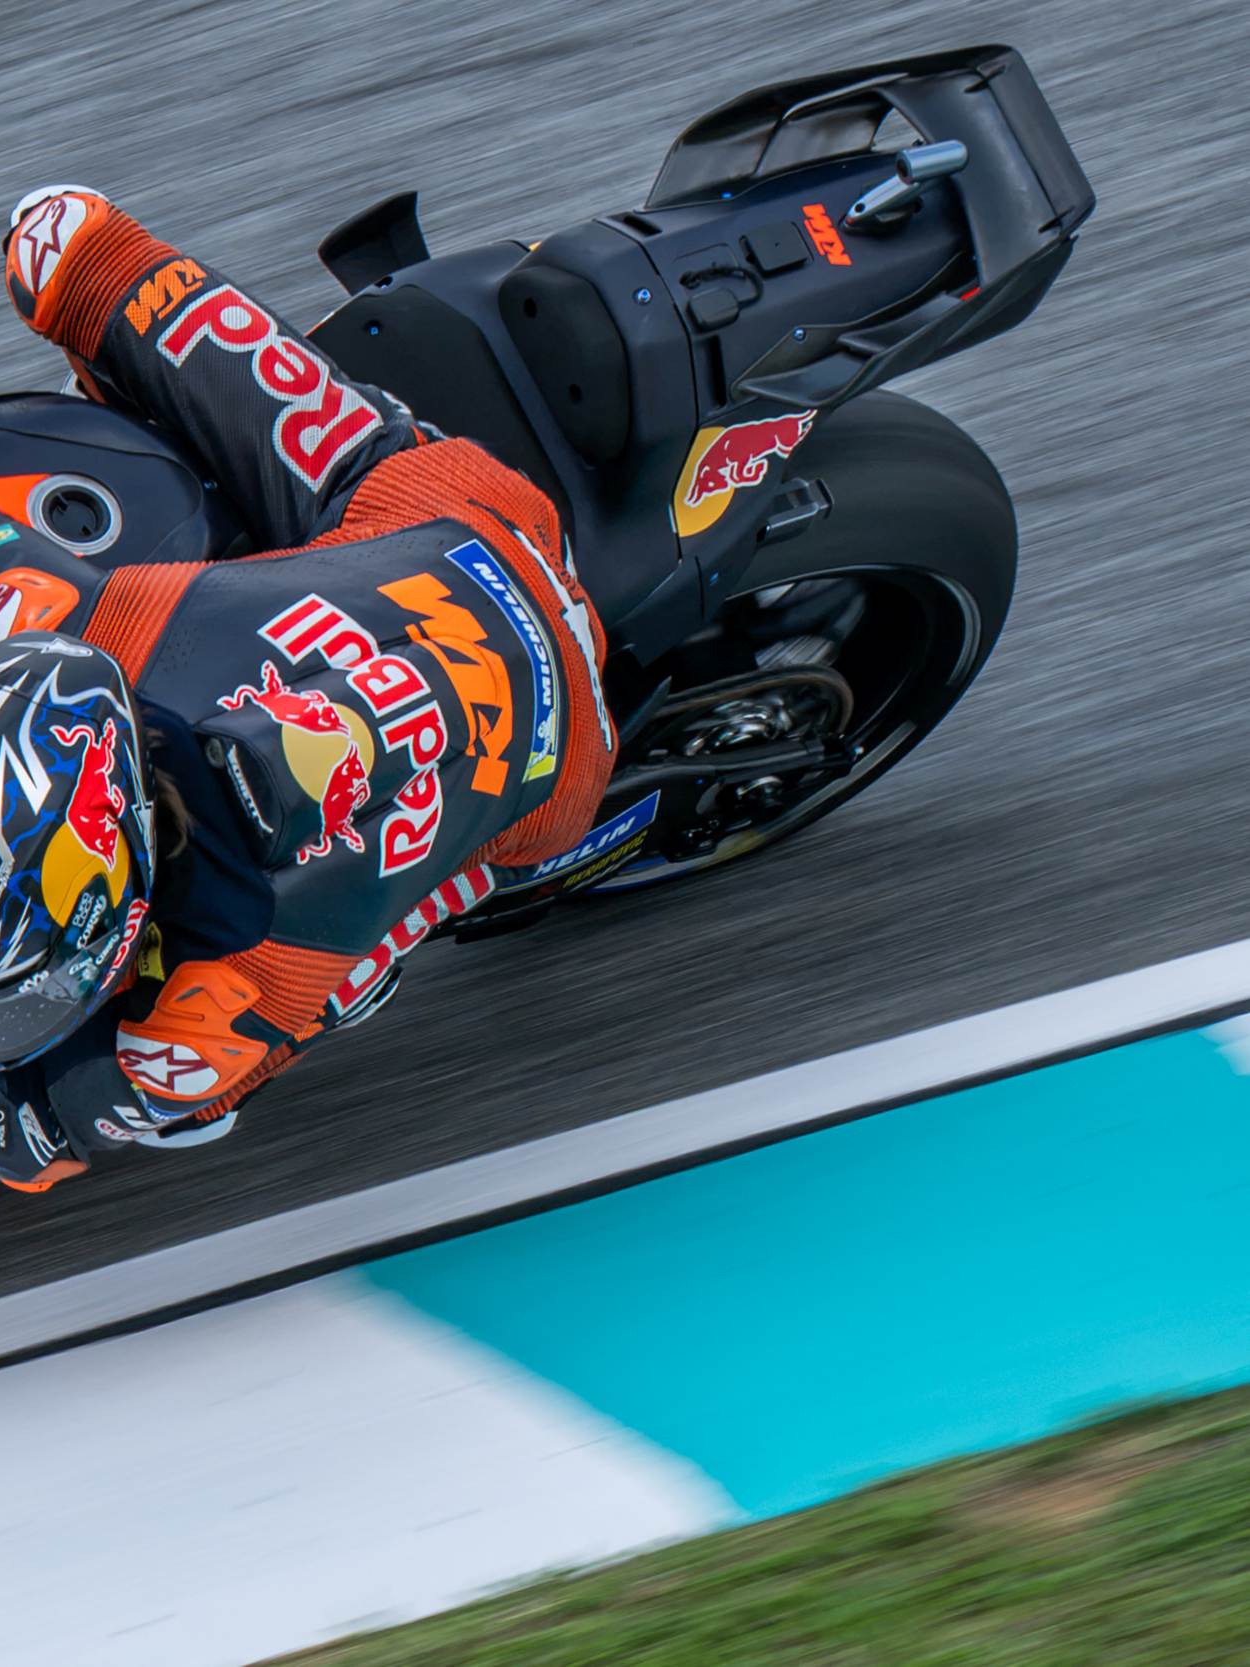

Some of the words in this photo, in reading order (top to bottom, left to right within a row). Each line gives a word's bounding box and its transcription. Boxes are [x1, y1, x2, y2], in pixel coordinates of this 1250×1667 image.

[802, 203, 853, 267] KTM
[124, 258, 207, 336] KTM
[157, 284, 384, 494] Red
[377, 572, 513, 797] KTM
[472, 561, 554, 708] MICHELIN
[533, 817, 635, 877] HELIN
